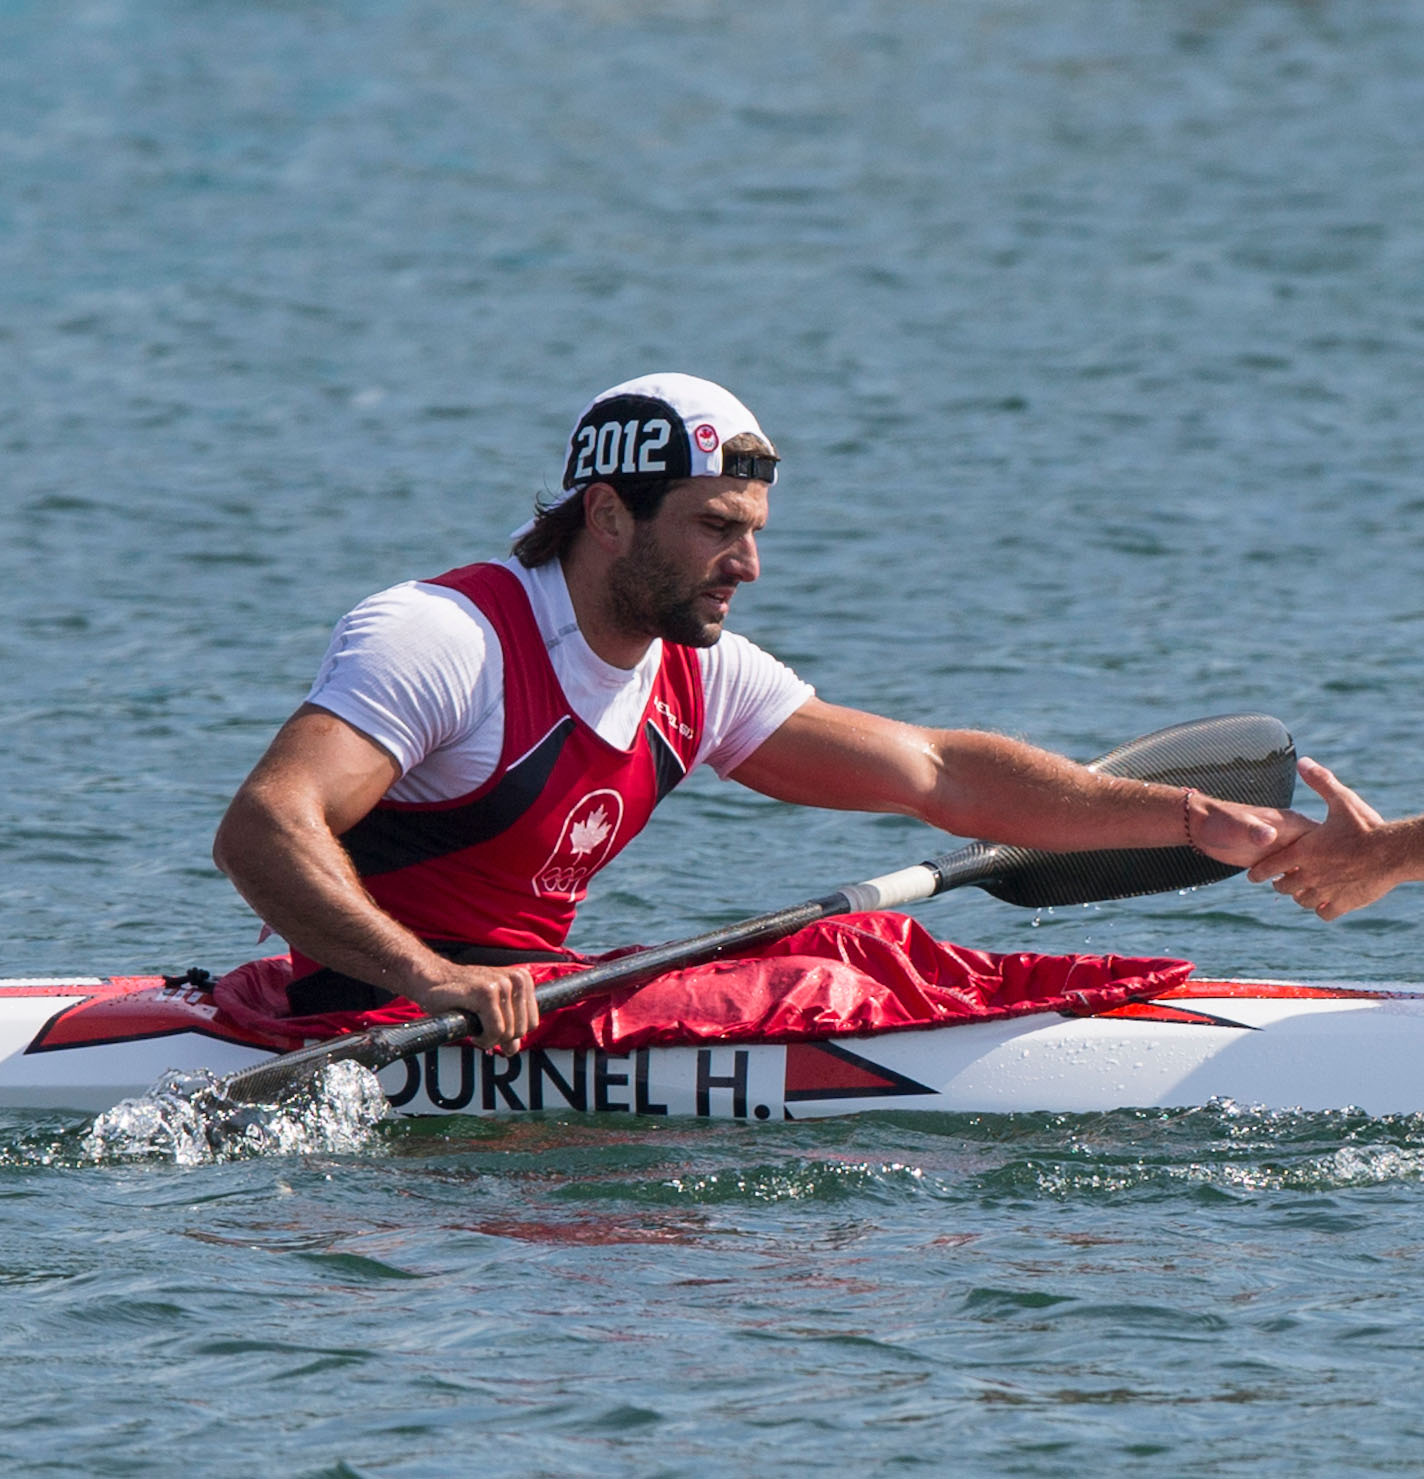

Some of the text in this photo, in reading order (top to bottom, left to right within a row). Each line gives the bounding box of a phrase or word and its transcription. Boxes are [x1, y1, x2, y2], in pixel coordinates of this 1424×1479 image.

[574, 418, 671, 479] 2012
[383, 1046, 771, 1120] OURNEL H.
